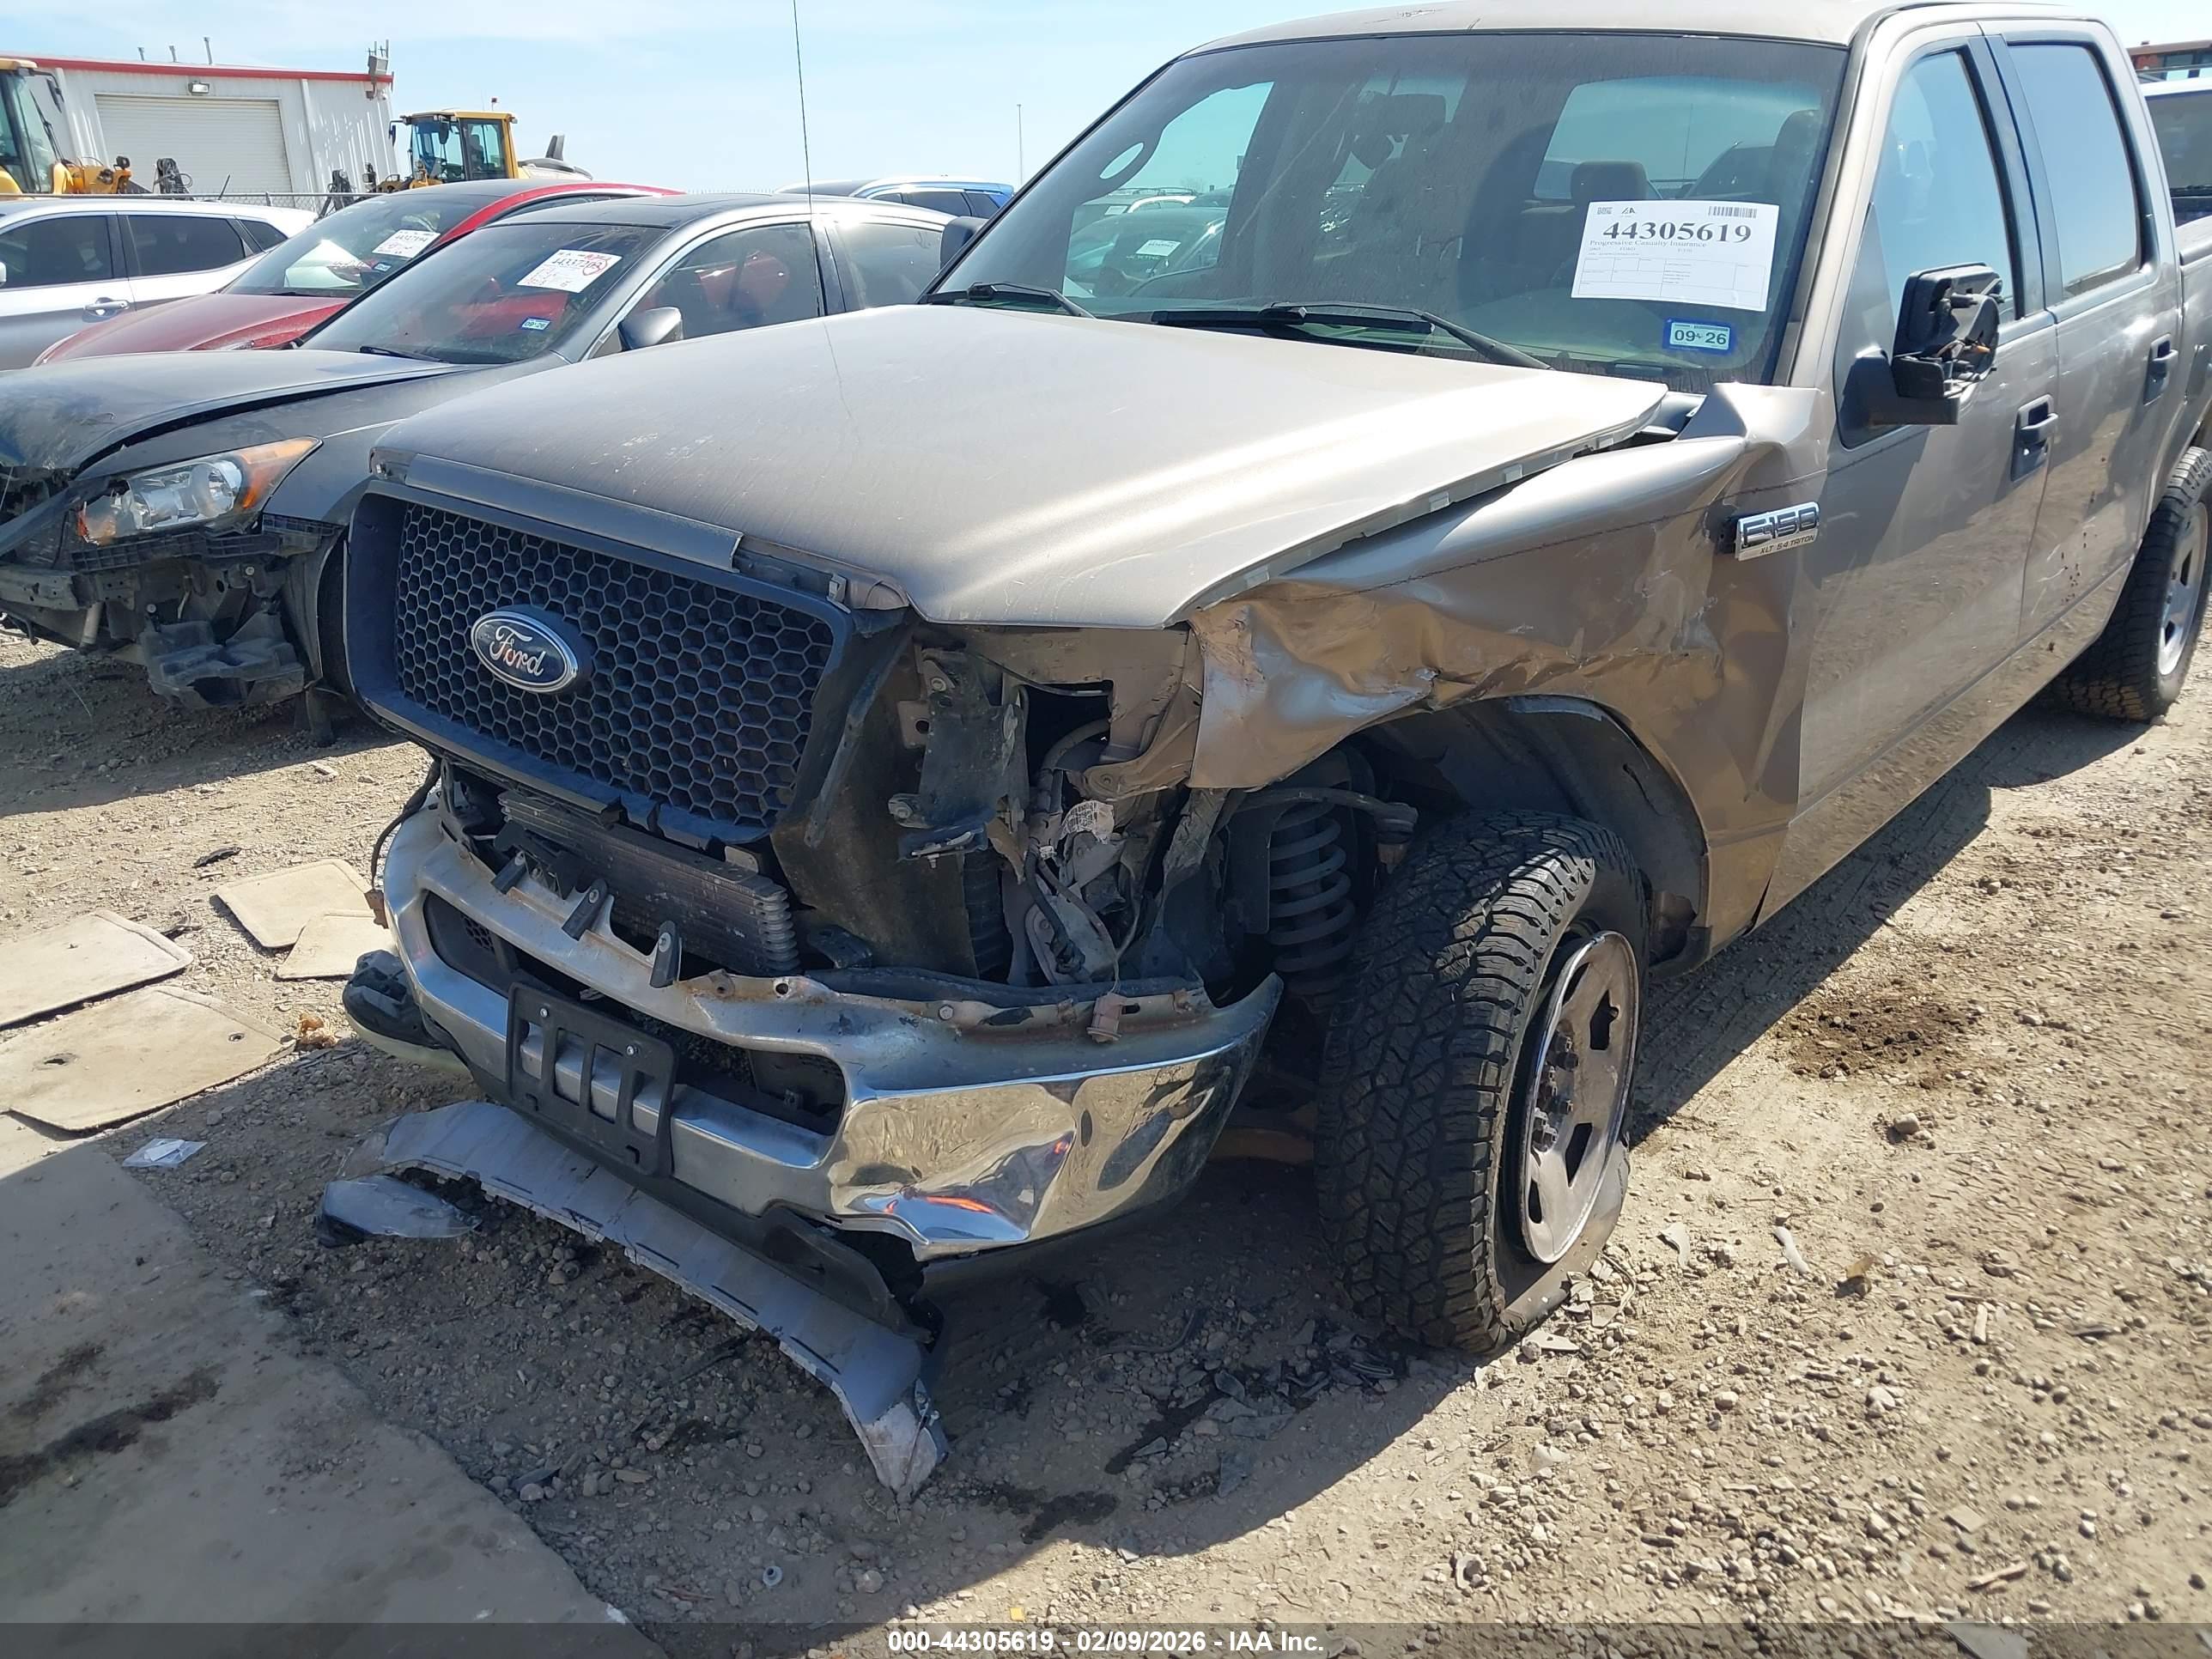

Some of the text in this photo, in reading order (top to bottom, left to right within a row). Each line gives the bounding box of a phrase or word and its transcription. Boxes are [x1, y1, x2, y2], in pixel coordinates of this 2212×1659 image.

[1602, 222, 1752, 243] 44305619
[1674, 330, 1727, 344] 09 26
[1760, 545, 1773, 554] XLT
[1790, 535, 1814, 546] TRITON
[489, 625, 547, 677] Ford
